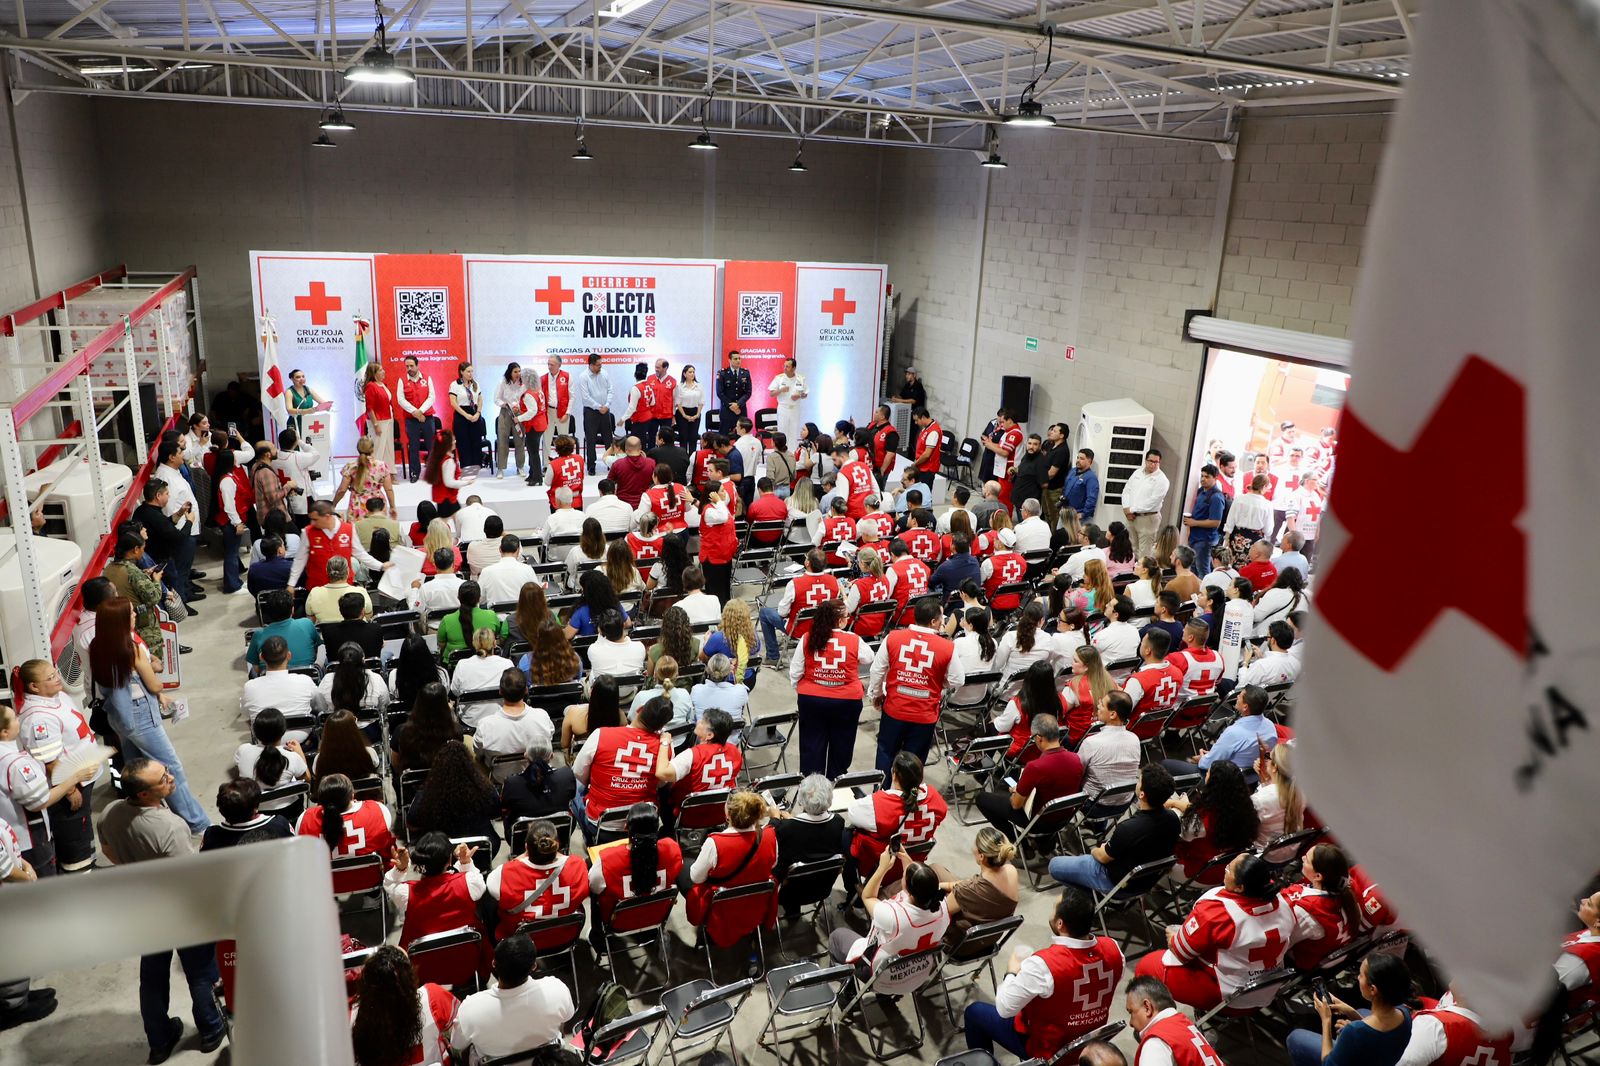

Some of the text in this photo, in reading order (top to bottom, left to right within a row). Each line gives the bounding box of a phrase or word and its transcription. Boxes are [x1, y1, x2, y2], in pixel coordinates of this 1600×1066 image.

[588, 277, 648, 288] CIERRE DE
[583, 315, 642, 338] ANUAL
[645, 315, 656, 338] 2026
[896, 675, 928, 685] MEXICANA
[913, 672, 929, 680] ROJA
[1070, 1011, 1090, 1020] CRUZ
